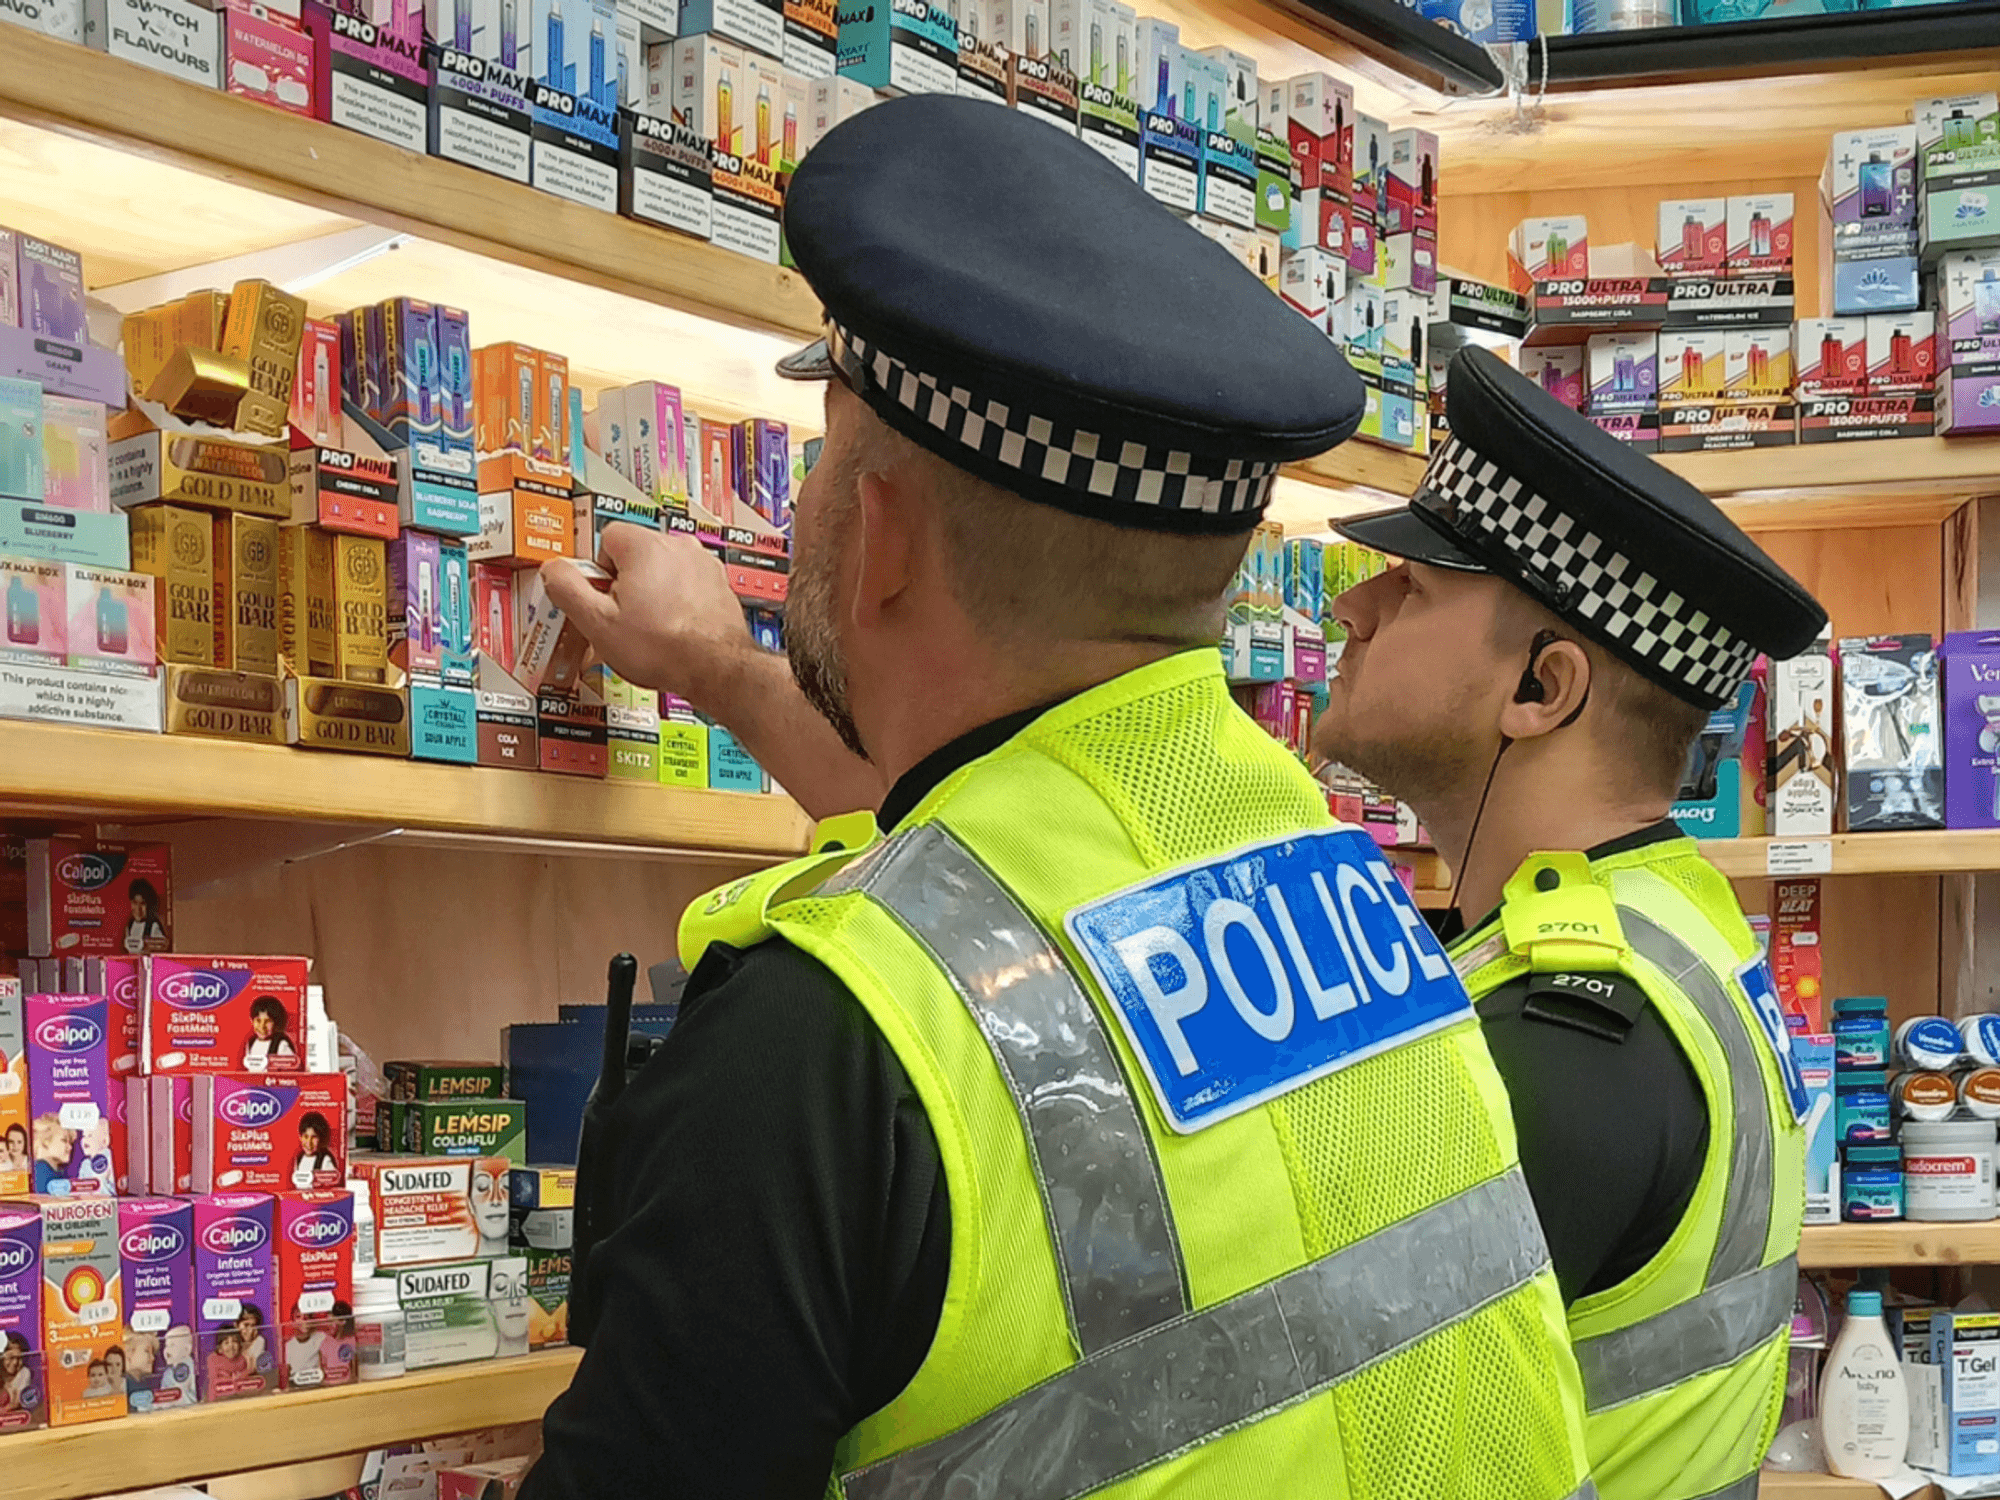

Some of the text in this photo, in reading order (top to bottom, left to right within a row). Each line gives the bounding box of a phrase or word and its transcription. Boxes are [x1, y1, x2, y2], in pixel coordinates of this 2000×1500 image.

[234, 29, 295, 60] WATERMELON
[334, 13, 418, 62] PRO MAX
[113, 28, 210, 73] FLAVOURS
[442, 51, 524, 93] PRO MAX
[1019, 59, 1074, 87] PRO MAX
[344, 82, 417, 117] This product contains
[450, 76, 487, 94] 4000+
[490, 88, 525, 110] PUFFS
[1084, 83, 1136, 114] PRO MAX
[337, 94, 422, 132] nicotine which is a highly
[536, 88, 573, 113] PRO
[577, 101, 610, 128] MAX
[345, 111, 413, 140] addictive substance
[1149, 115, 1174, 134] PRO
[636, 117, 706, 154] PRO MAX
[1210, 135, 1234, 152] PRO
[643, 139, 676, 158] 4000+
[678, 151, 707, 171] PUFFS
[743, 162, 774, 186] MAX
[714, 171, 775, 201] 4000+ PUFFS
[24, 238, 77, 264] LOST MARY
[1459, 283, 1517, 307] PRO ULTRA
[1547, 279, 1643, 294] PRO ULTRA
[1673, 282, 1770, 299] PRO ULTRA
[1571, 309, 1632, 319] RASPBERRY COLA
[1697, 312, 1759, 321] WATERMELON ICE
[45, 360, 73, 373] GRAPE
[252, 354, 291, 382] GOLD
[250, 370, 288, 402] BAR
[1673, 407, 1770, 423] PRO ULTRA
[1812, 400, 1909, 415] PRO ULTRA
[1829, 413, 1907, 425] 15000+PUFFS
[1837, 430, 1878, 438] RASPBERRY
[321, 449, 388, 474] PRO MINI
[180, 475, 275, 507] GOLD BAR
[335, 480, 380, 497] CHERRY COLA
[426, 506, 468, 521] RASPBERRY
[597, 495, 654, 517] PRO MINI
[24, 527, 74, 540] BLUEBERRY
[671, 516, 720, 536] PRO MINI
[728, 528, 783, 550] PRO MINI
[14, 563, 59, 577] MAX BOX
[75, 570, 147, 589] ELUX MAX BOX
[169, 582, 209, 602] GOLD
[236, 590, 275, 610] GOLD
[171, 603, 210, 623] BAR
[238, 606, 277, 630] BAR
[343, 600, 383, 619] GOLD
[346, 617, 384, 637] BAR
[2, 672, 23, 684] This
[26, 676, 65, 690] product
[66, 680, 107, 693] contains
[36, 690, 65, 703] which
[66, 693, 75, 703] is
[85, 695, 115, 710] highly
[541, 700, 568, 714] PRO
[28, 703, 124, 723] addictive substance.
[184, 708, 273, 736] GOLD BAR
[428, 708, 465, 724] CRYSTAL
[316, 719, 395, 745] GOLD BAR
[424, 732, 466, 748] SOUR APPLE
[497, 733, 519, 745] COLA
[502, 746, 515, 757] ICE
[667, 739, 695, 750] CRYSTAL
[616, 750, 651, 768] SKITZ
[719, 768, 752, 781] SOUR APPLE
[1787, 788, 1821, 798] Double
[1668, 806, 1716, 823] MACH3
[62, 862, 105, 883] Calpol
[1778, 885, 1816, 898] DEEP
[1778, 900, 1814, 913] HEAT
[1537, 922, 1600, 935] 2701
[212, 960, 225, 970] 6+
[1113, 860, 1451, 1077] POLICE
[166, 981, 221, 1002] Calpol
[1552, 973, 1615, 998] 2701
[171, 1012, 215, 1024] SixPlus
[43, 1025, 94, 1046] Calpol
[166, 1024, 220, 1034] FastMelts
[1917, 1032, 1955, 1049] Vaseline
[53, 1067, 89, 1079] Infant
[265, 1077, 277, 1087] 6+
[429, 1077, 491, 1095] LEMSIP
[1911, 1088, 1949, 1098] Vaseline
[226, 1099, 273, 1120] Calpol
[433, 1114, 511, 1134] LEMSIP
[230, 1130, 269, 1141] SixPlus
[227, 1141, 273, 1152] FastMelts
[384, 1170, 452, 1192] SUDAFED
[383, 1194, 434, 1206] CONGESTION
[383, 1202, 450, 1215] HEADACHE RELIEF
[46, 1203, 112, 1222] NUROFEN
[46, 1218, 100, 1232] FOR CHILDREN
[295, 1220, 342, 1240] Calpol
[126, 1233, 176, 1254] Calpol
[209, 1226, 258, 1246] Calpol
[218, 1257, 253, 1270] Infant
[300, 1252, 338, 1263] SixPlus
[529, 1256, 572, 1275] LEMS
[135, 1274, 171, 1289] Infant
[404, 1272, 470, 1294] SUDAFED
[404, 1299, 432, 1310] MUCUS
[50, 1325, 99, 1343] 3 9
[1958, 1356, 1996, 1374] T Gel
